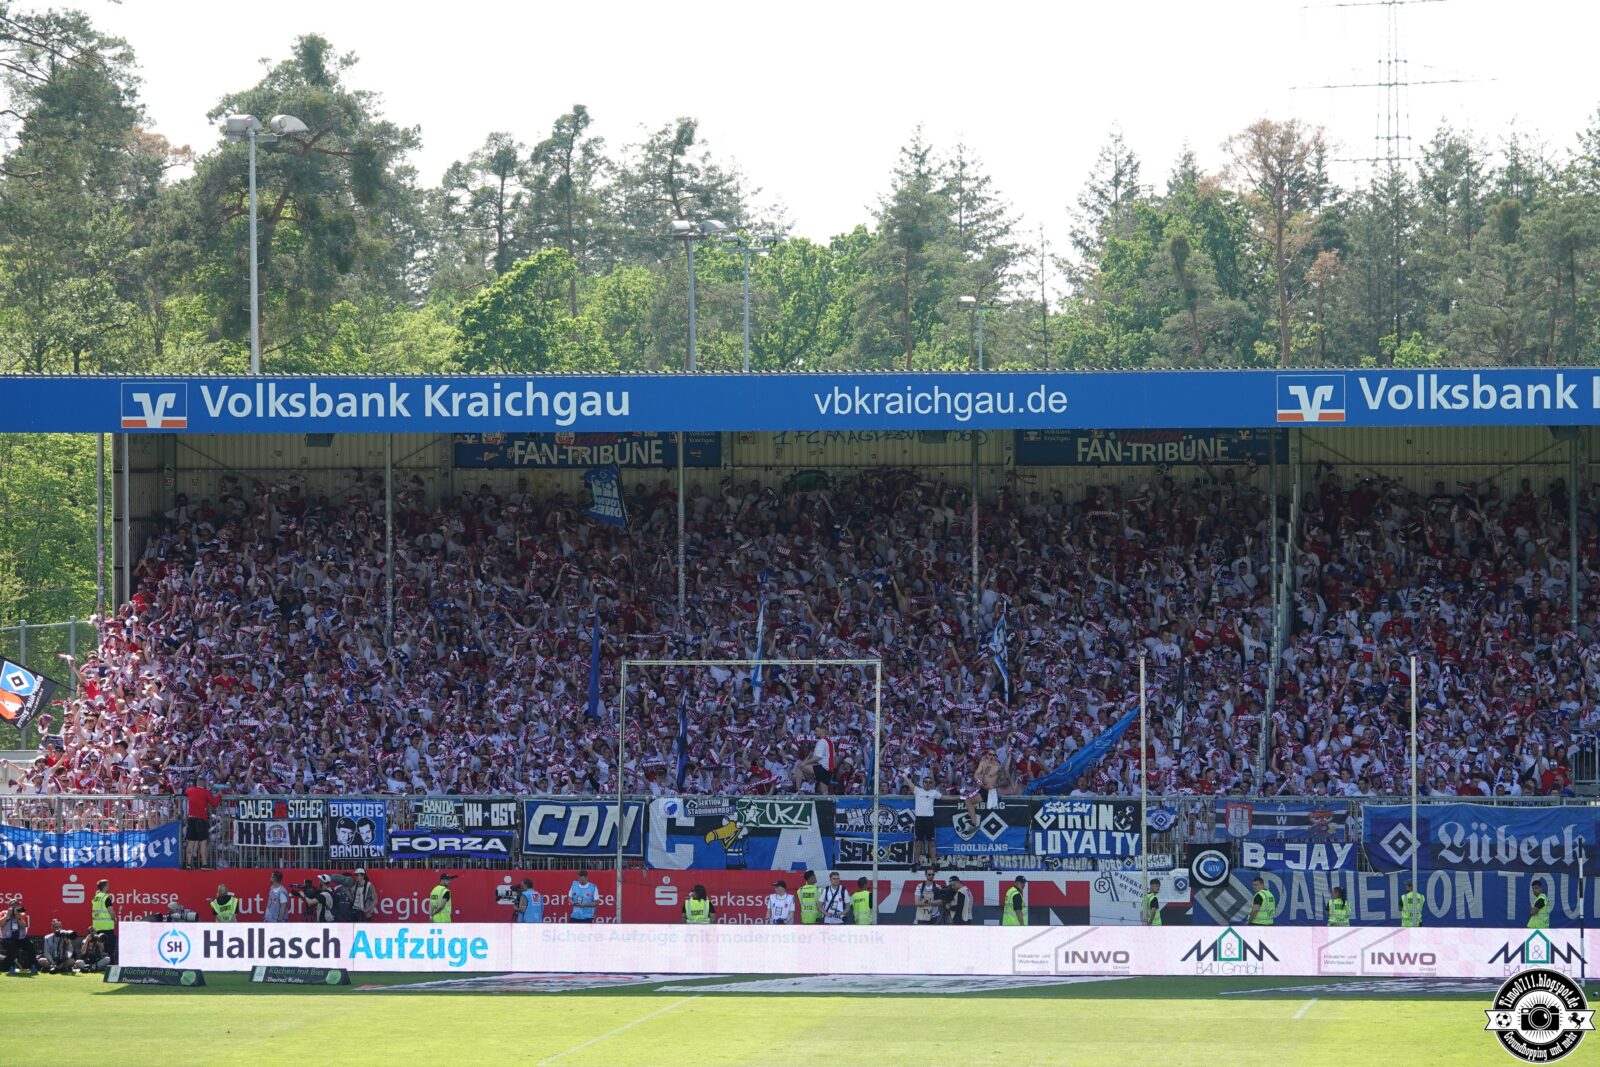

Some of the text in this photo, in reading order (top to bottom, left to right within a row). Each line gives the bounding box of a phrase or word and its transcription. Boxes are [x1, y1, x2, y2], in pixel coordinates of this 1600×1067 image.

[199, 381, 631, 427] Volksbank Kraichgau
[814, 384, 1068, 421] vbkraichgau.de
[1358, 373, 1579, 411] Volksbank
[513, 438, 663, 466] FAN-TRIBÜNE
[1077, 434, 1229, 463] FAN-TRIBÜNE
[239, 800, 323, 819] DAUER STEHER
[330, 803, 384, 817] BIERIGE
[423, 800, 455, 814] BANDA
[463, 803, 517, 827] HH OST
[418, 814, 458, 829] CAOTICA
[528, 805, 639, 847] CDN
[330, 845, 385, 858] BANDITEN
[391, 837, 508, 852] FORZA
[953, 843, 1009, 852] HOOLIGANS
[1035, 830, 1140, 856] LOYALTY
[1437, 821, 1590, 867] Lübeck
[1243, 842, 1353, 870] B-JAY
[1426, 870, 1484, 921] ON
[1498, 871, 1600, 921] TOU
[167, 928, 489, 967] SH Hallasch Aufzüge
[541, 929, 885, 945] Sichere Aufzüge mit modernster Technik
[1064, 951, 1130, 964] INWO
[1196, 962, 1264, 974] BAU GmbH
[1371, 952, 1437, 965] INWO
